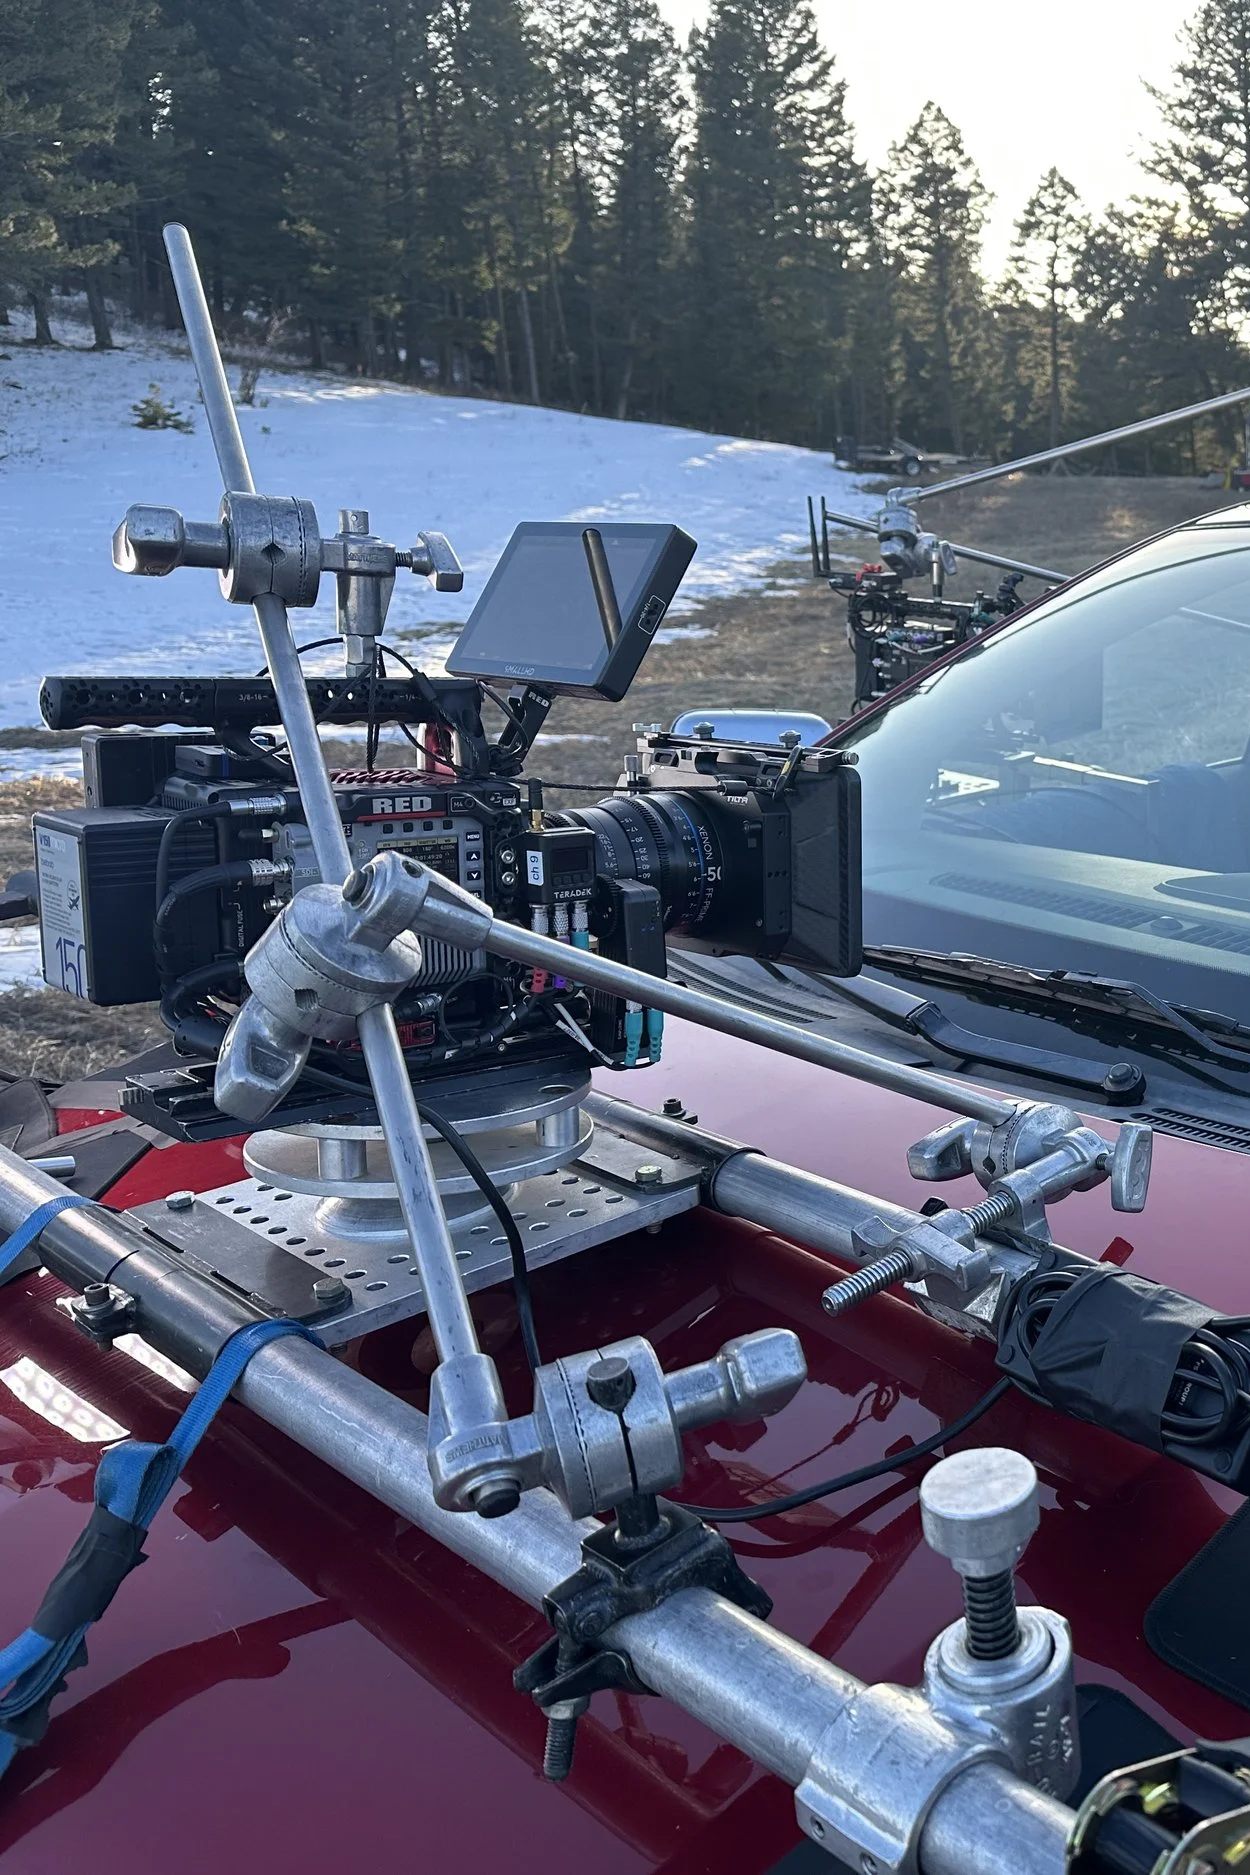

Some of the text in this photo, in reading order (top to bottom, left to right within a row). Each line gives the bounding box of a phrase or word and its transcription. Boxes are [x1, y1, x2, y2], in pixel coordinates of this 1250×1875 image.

[528, 691, 550, 708] RED
[372, 796, 432, 814] RED
[727, 795, 749, 804] TILTA
[697, 825, 714, 861] XENON
[530, 855, 540, 881] ch 9
[553, 888, 592, 899] TERADEK
